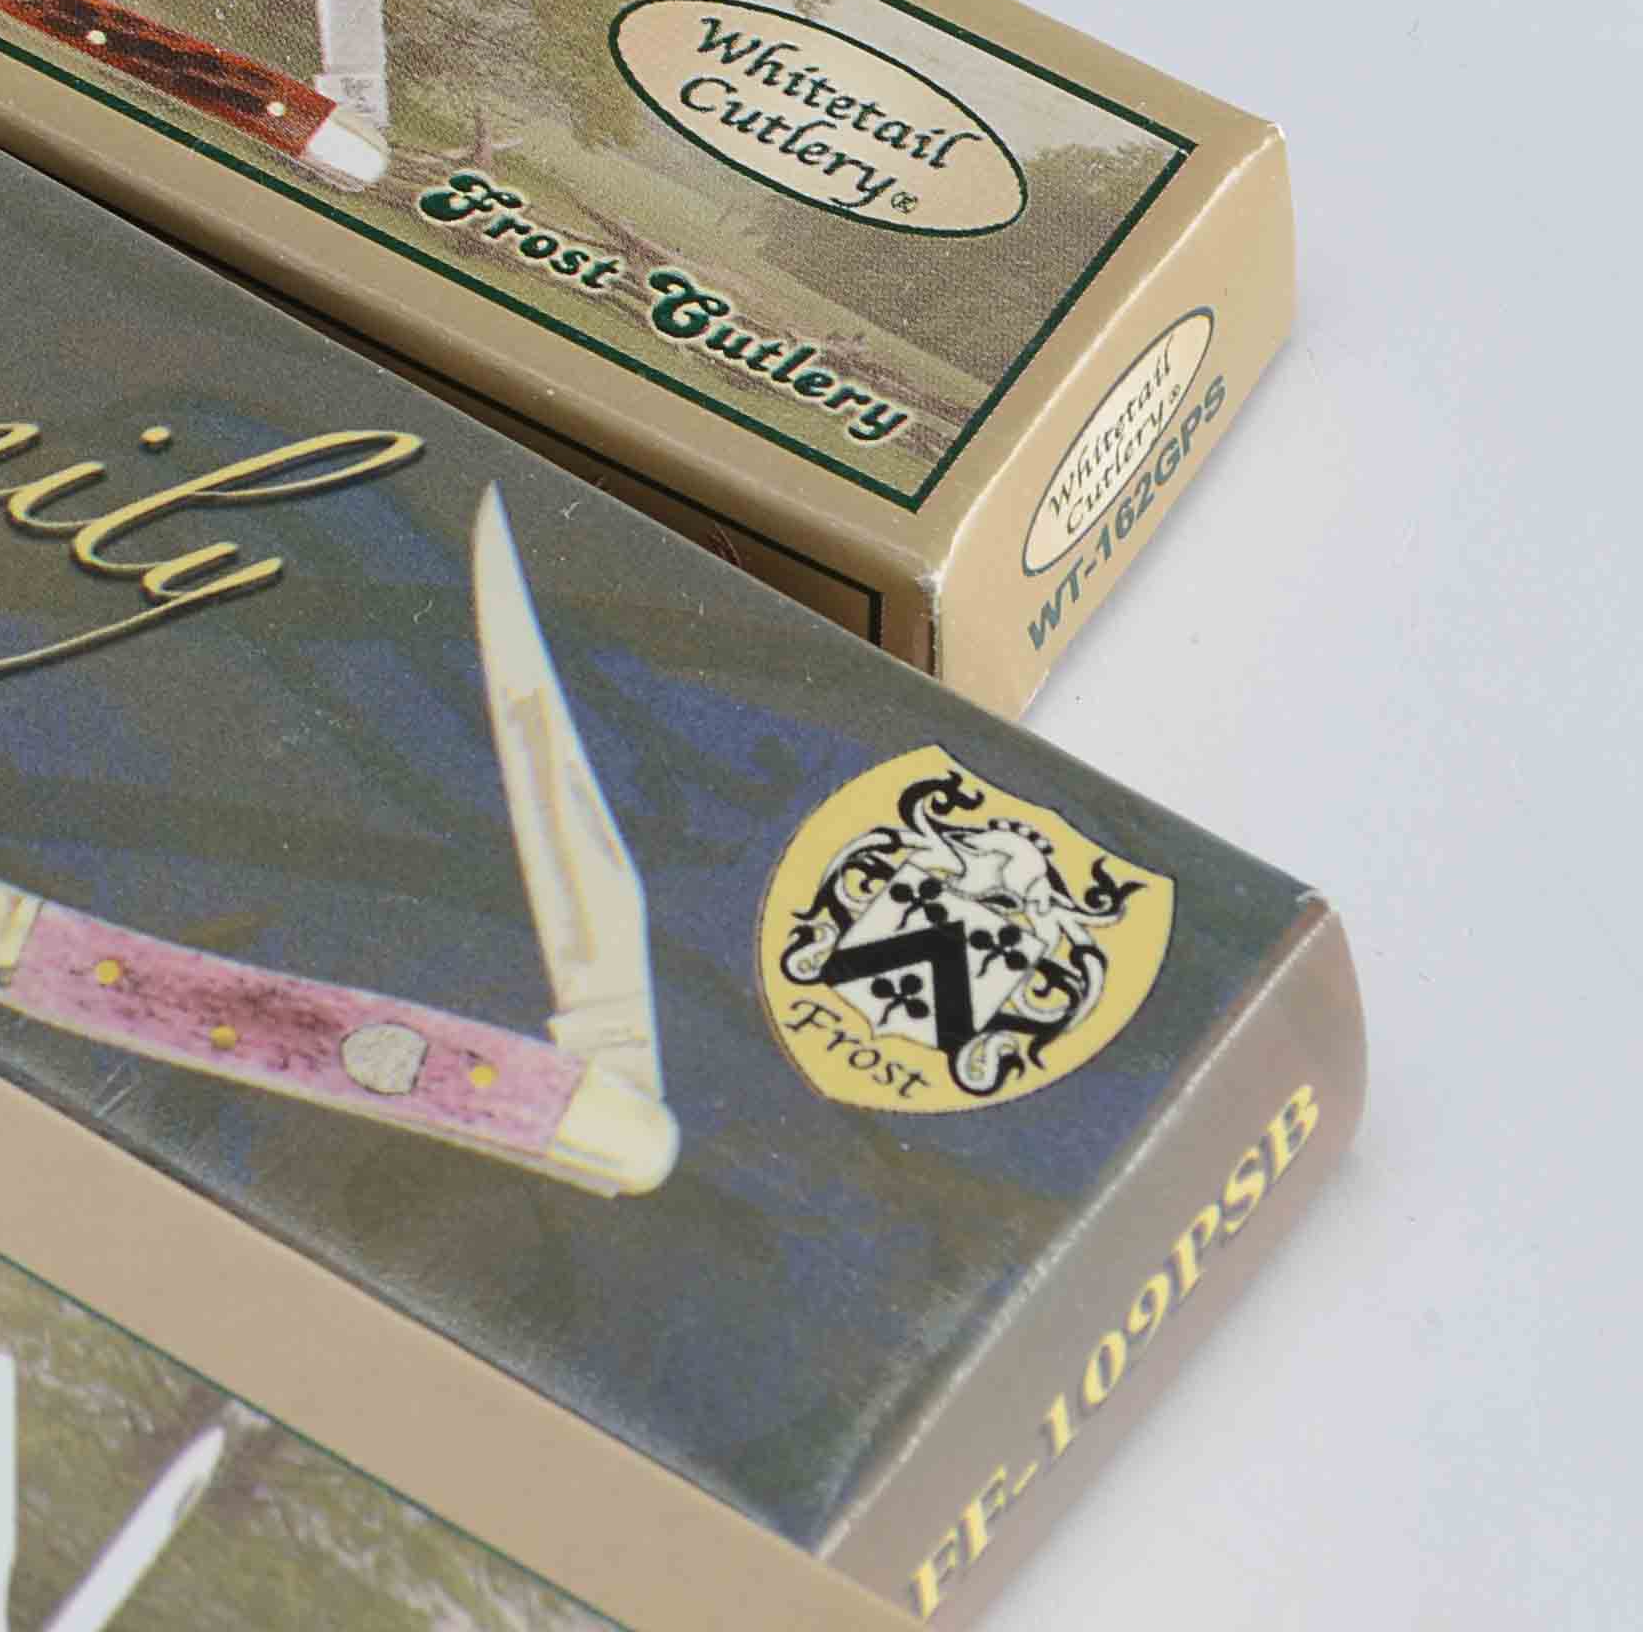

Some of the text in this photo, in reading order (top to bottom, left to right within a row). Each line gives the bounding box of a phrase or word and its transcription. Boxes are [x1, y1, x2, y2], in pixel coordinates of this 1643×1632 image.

[697, 15, 984, 169] Whitetail
[419, 171, 906, 442] Frost Cutlery
[1027, 375, 1226, 650] WT-162GPS
[1050, 335, 1174, 517] Whitetail
[785, 999, 931, 1099] Frost
[908, 1083, 1319, 1624] FF-109PSB
